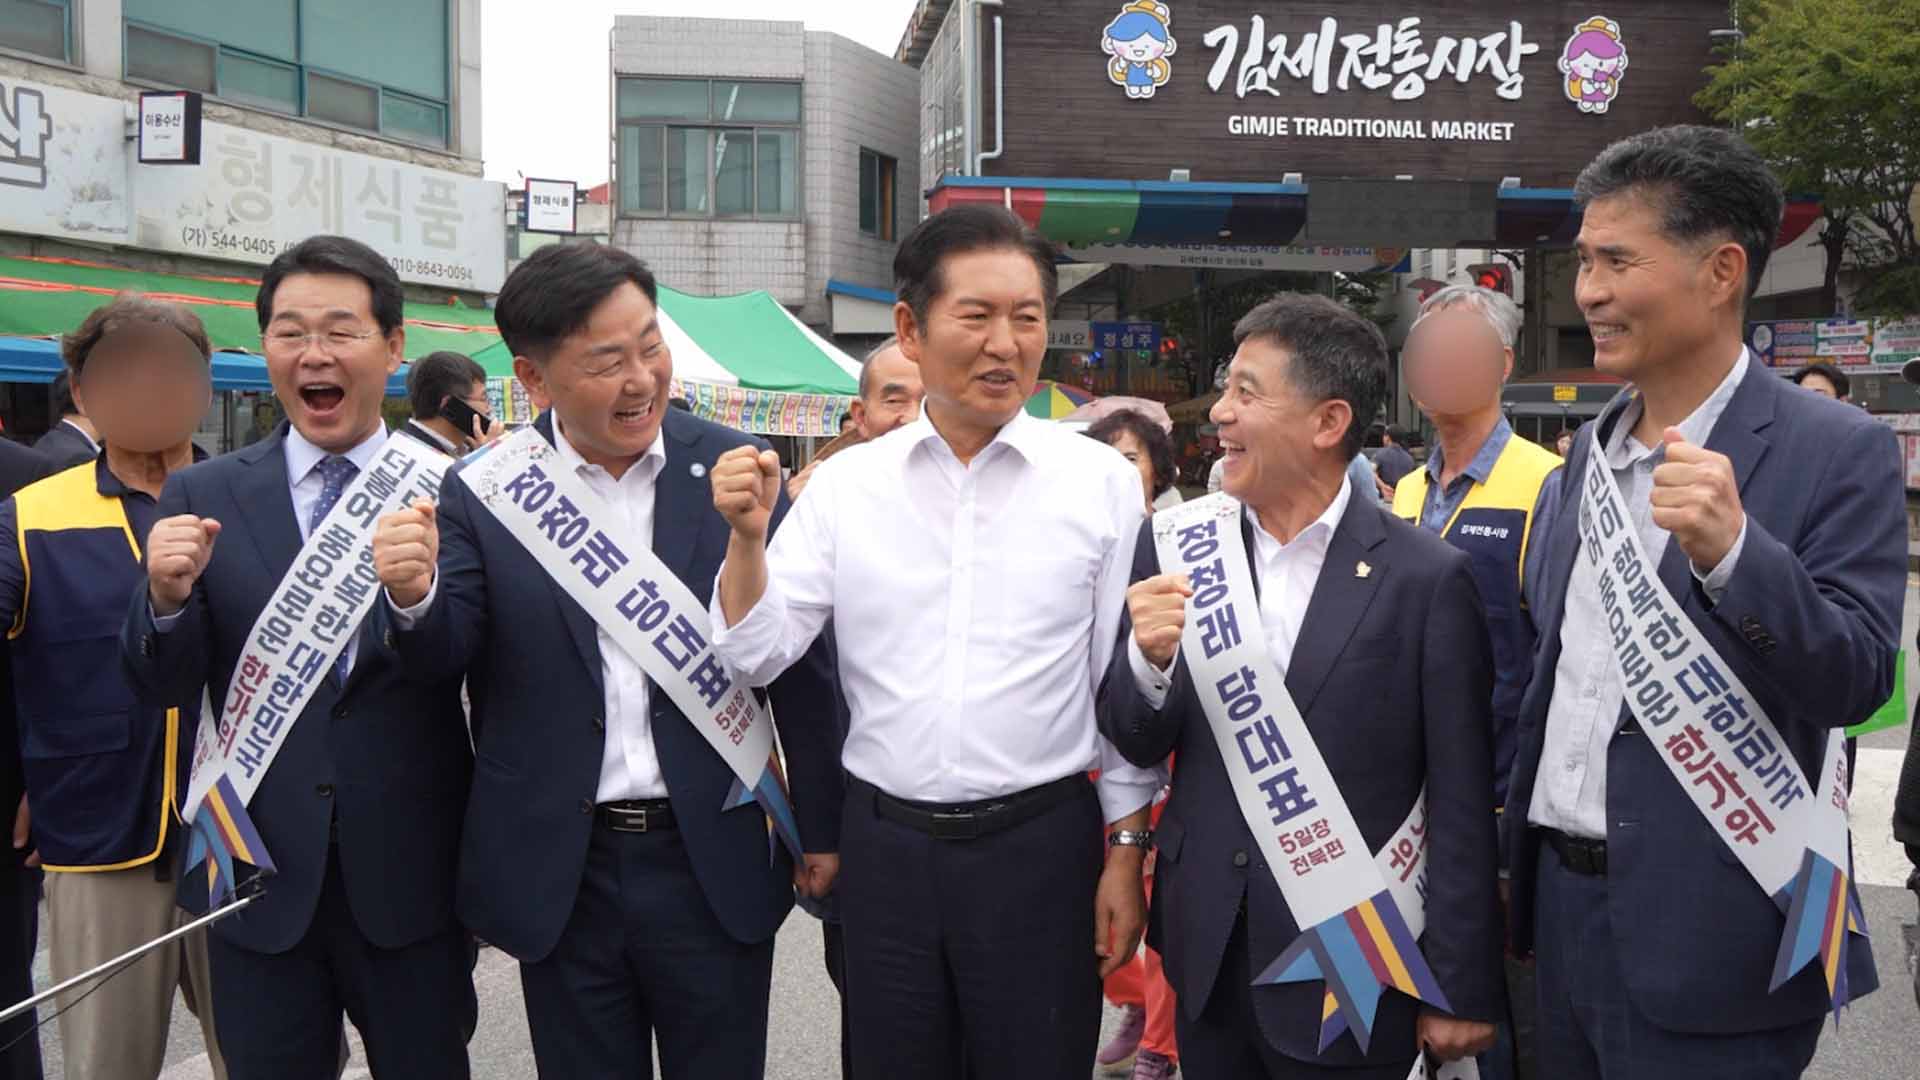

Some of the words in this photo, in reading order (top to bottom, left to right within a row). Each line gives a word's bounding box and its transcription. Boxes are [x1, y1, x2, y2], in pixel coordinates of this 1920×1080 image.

[1203, 14, 1539, 100] 김제전통시장
[1228, 115, 1289, 135] GIMJE
[1293, 117, 1426, 139] TRADITIONAL
[1431, 120, 1515, 141] MARKET
[217, 134, 464, 250] 형제식품
[182, 225, 207, 247] (가)
[211, 231, 276, 255] 544-0405
[345, 448, 417, 529] 더불어
[256, 523, 357, 655] 풍요로운
[503, 464, 630, 589] 정청래
[615, 578, 732, 709] 당대표
[218, 653, 271, 758] 한가위
[235, 640, 328, 779] 대한민국
[714, 689, 746, 731] 5일장
[1176, 519, 1242, 660] 정청래
[1216, 664, 1319, 826] 당대표
[1598, 567, 1680, 727] 풍요로운
[1664, 723, 1777, 846] 한가위
[1612, 536, 1691, 662] 행복한
[1674, 653, 1805, 811] 대한민국
[729, 706, 756, 746] 전북편
[1277, 818, 1331, 855] 5일장
[1289, 837, 1346, 877] 전북편
